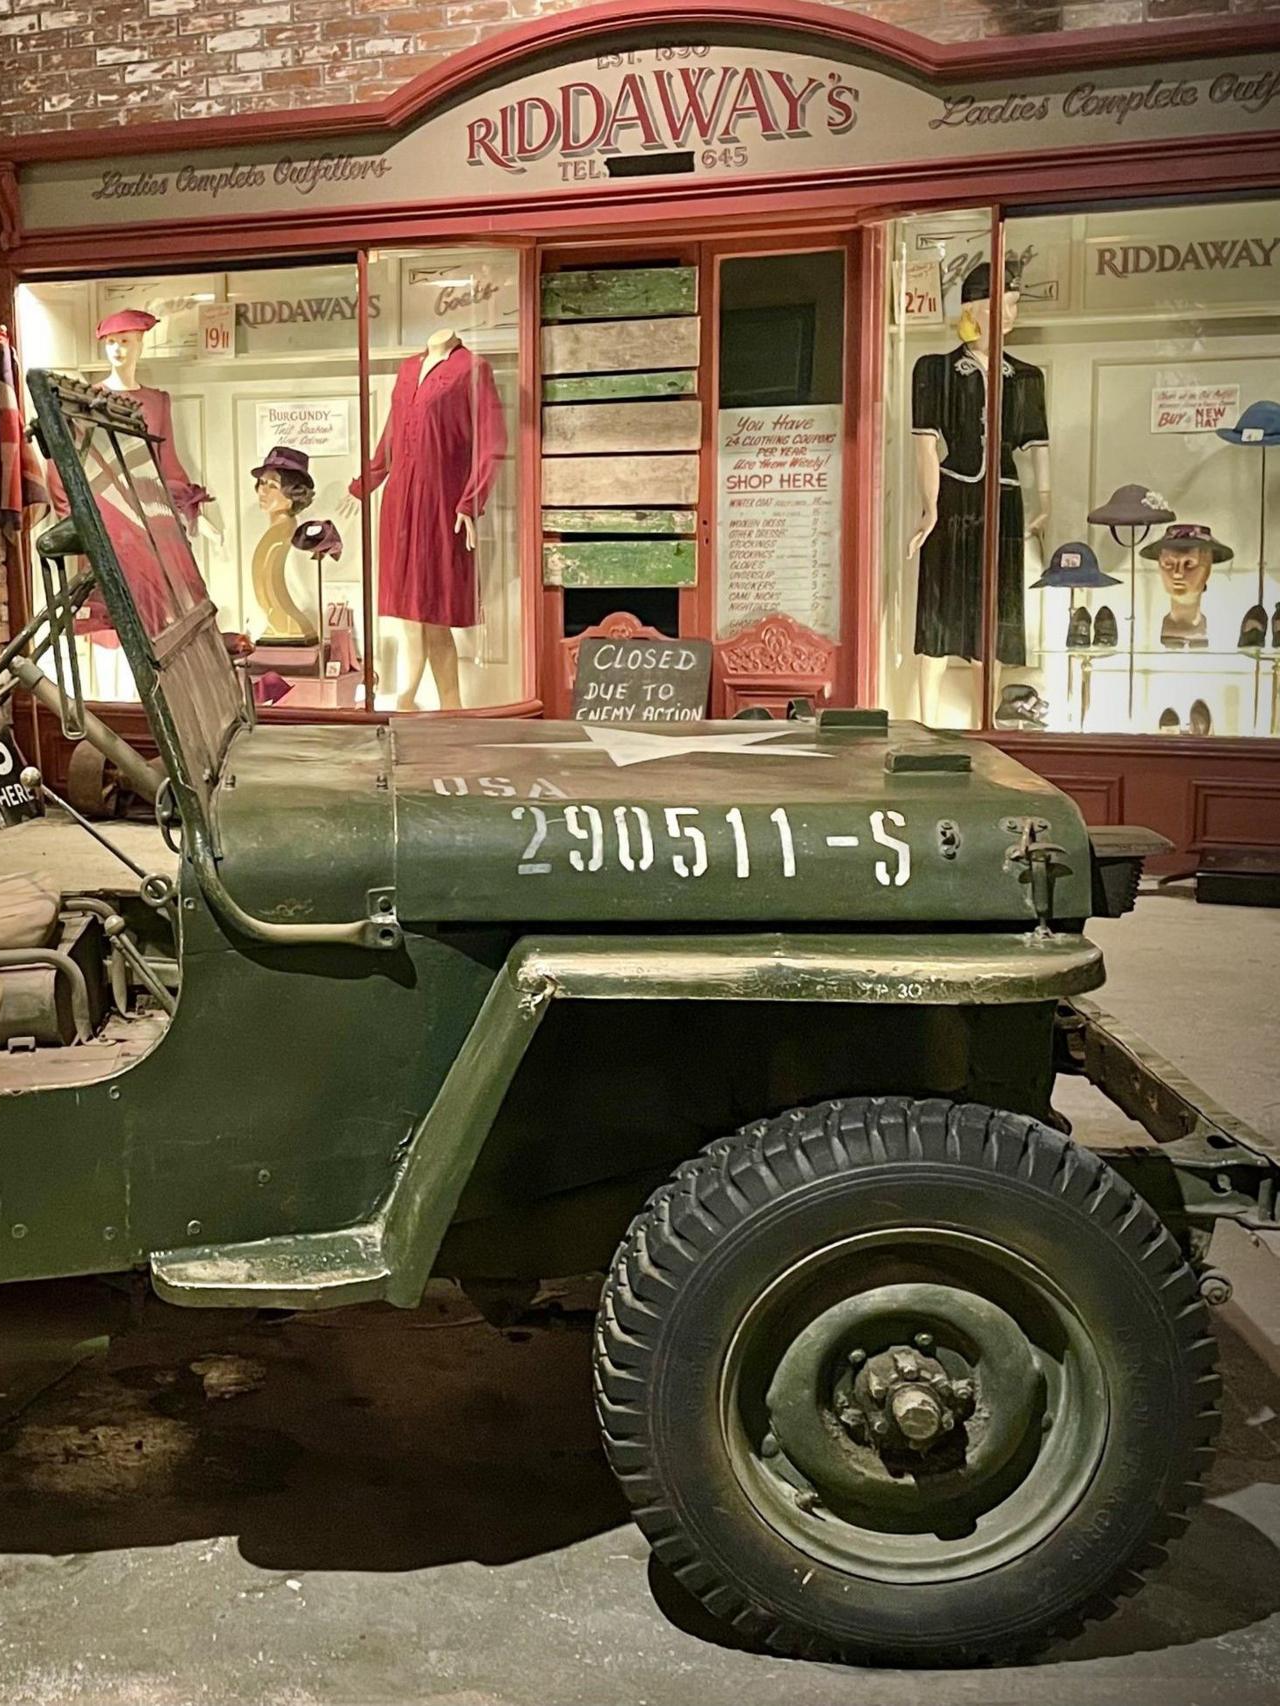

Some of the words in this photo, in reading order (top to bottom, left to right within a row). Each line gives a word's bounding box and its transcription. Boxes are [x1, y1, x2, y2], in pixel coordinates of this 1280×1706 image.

[928, 93, 1050, 130] Ladies
[1062, 80, 1199, 125] Complete
[466, 66, 860, 174] RIDDAWAY'S
[701, 146, 748, 170] 645
[91, 169, 170, 201] Ladies
[175, 163, 267, 198] Complete
[272, 152, 393, 196] Outfitters
[1195, 407, 1226, 418] NEW
[732, 416, 765, 436] You
[772, 414, 814, 431] Have
[1195, 419, 1219, 428] HAT
[725, 436, 740, 447] 24
[741, 435, 790, 447] CLOTHING
[756, 447, 778, 457] PER
[779, 446, 807, 456] YEAR
[726, 474, 773, 490] SHOP
[779, 472, 828, 489] HERE
[729, 539, 778, 549] STOCKINGS
[729, 560, 766, 569] GLOVES
[728, 581, 776, 590] KNICKERS
[593, 644, 697, 670] CLOSED
[584, 682, 629, 700] DUE
[642, 683, 674, 701] TO
[575, 704, 636, 721] ENEMY
[433, 777, 569, 799] USA
[898, 983, 922, 998] 30
